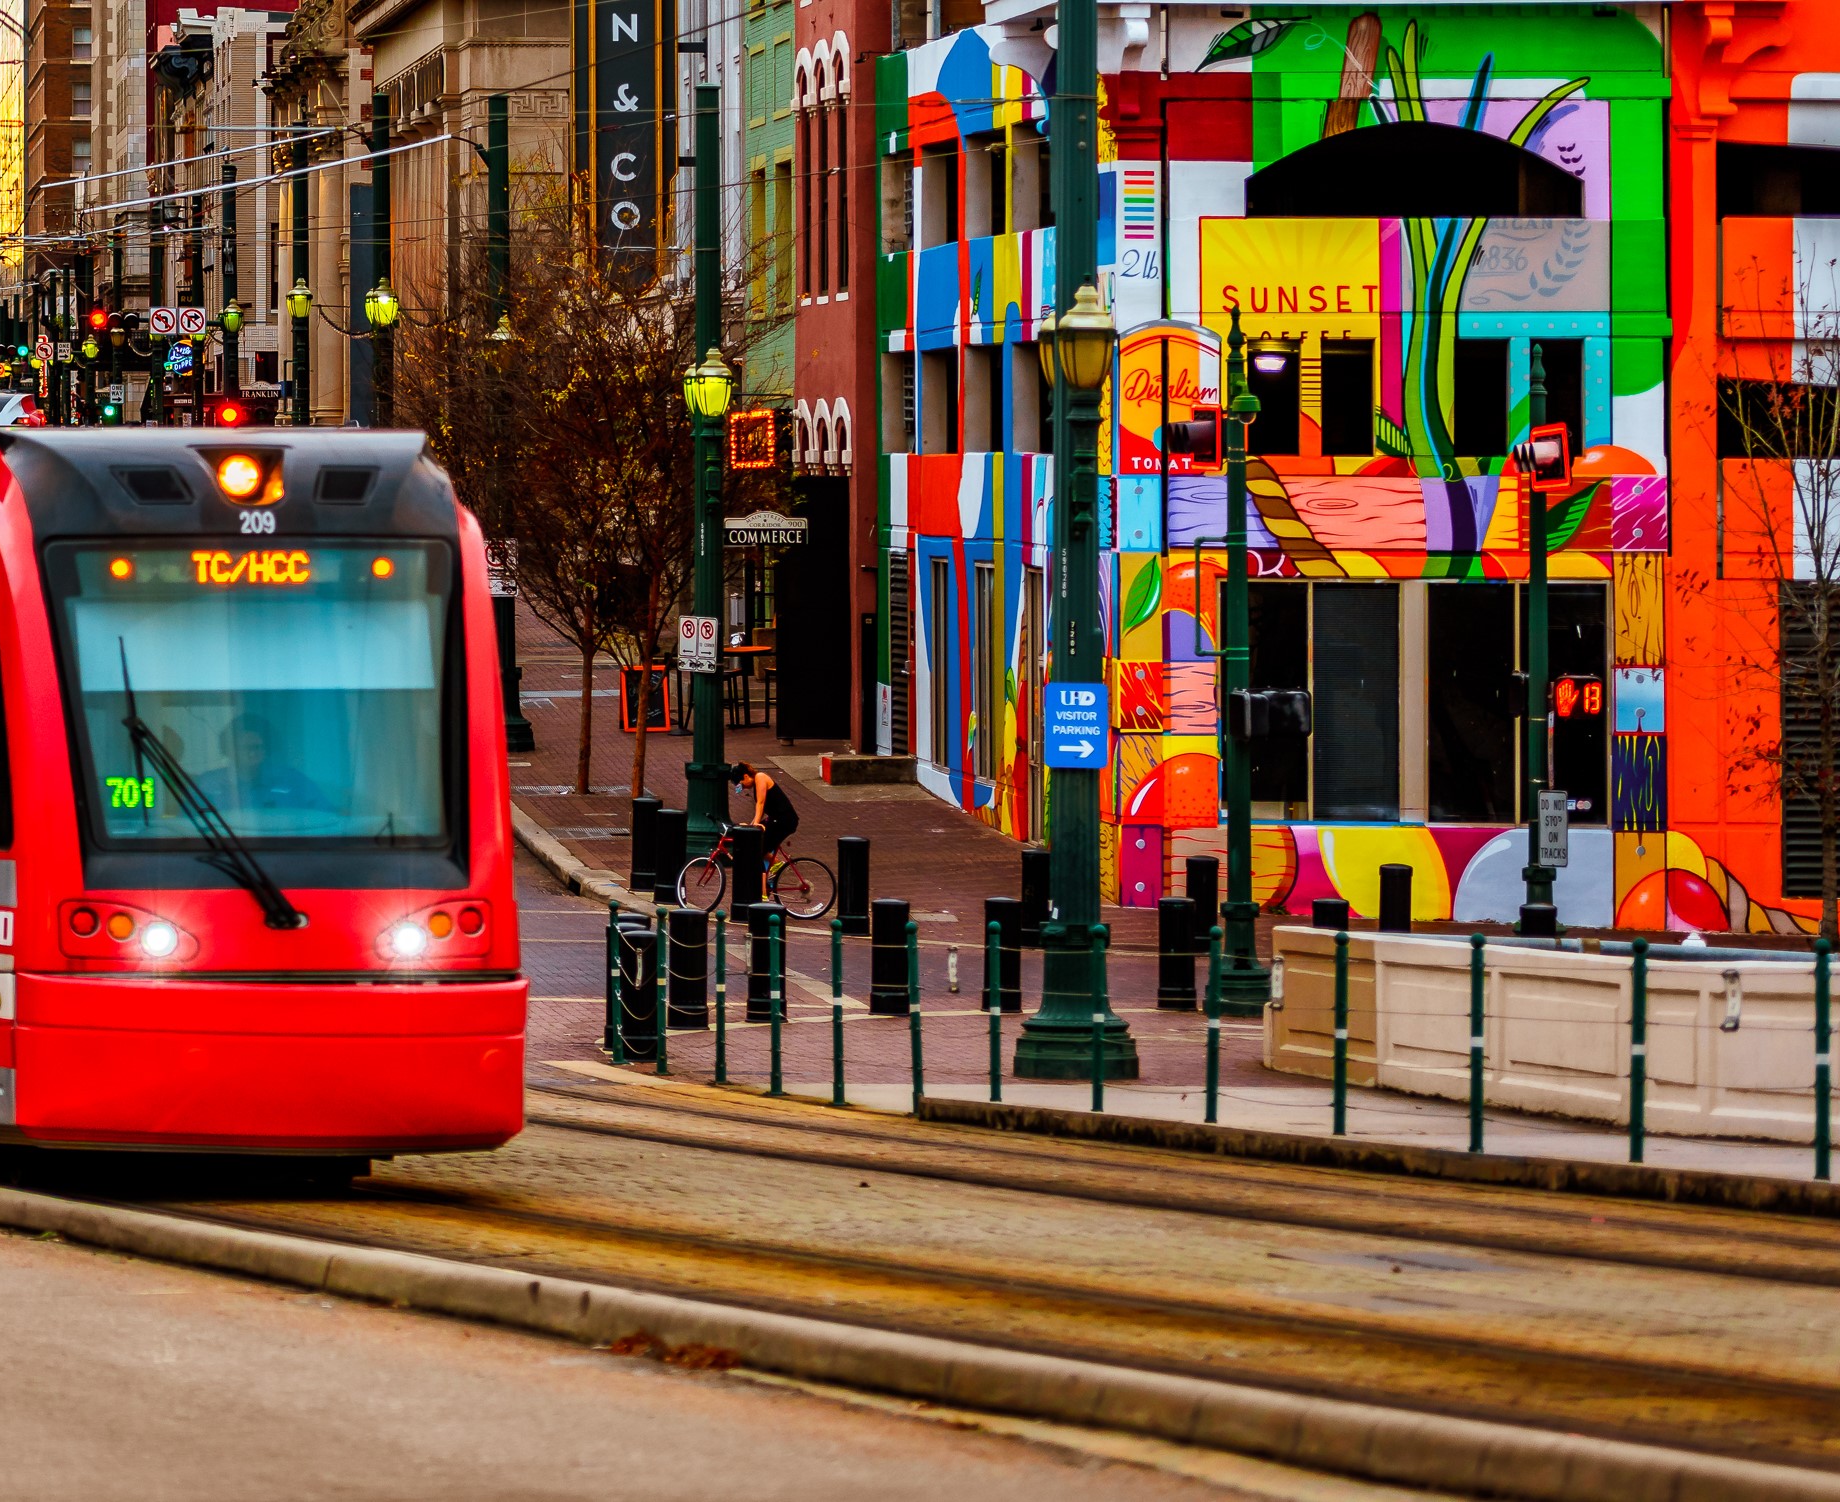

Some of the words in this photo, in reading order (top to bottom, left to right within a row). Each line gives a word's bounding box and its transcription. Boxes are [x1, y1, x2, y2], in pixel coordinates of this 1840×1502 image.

[1120, 249, 1140, 278] 2
[180, 295, 192, 303] RU
[1222, 284, 1378, 313] SUNSET
[174, 360, 192, 371] DIPPE
[241, 390, 279, 398] FRANKLIN
[239, 511, 276, 534] 209
[746, 514, 762, 524] MAIN
[763, 514, 785, 524] STREET
[729, 530, 802, 544] COMMERCE
[191, 550, 311, 584] TC/HCC
[1060, 690, 1096, 706] UHD
[1584, 683, 1602, 714] 13
[1056, 711, 1097, 721] VISITOR
[1053, 726, 1100, 735] PARKING
[105, 776, 155, 808] 701
[1541, 800, 1549, 810] DO
[1554, 800, 1565, 811] NOT
[1548, 832, 1558, 843] ON
[1541, 848, 1566, 859] TRACKS
